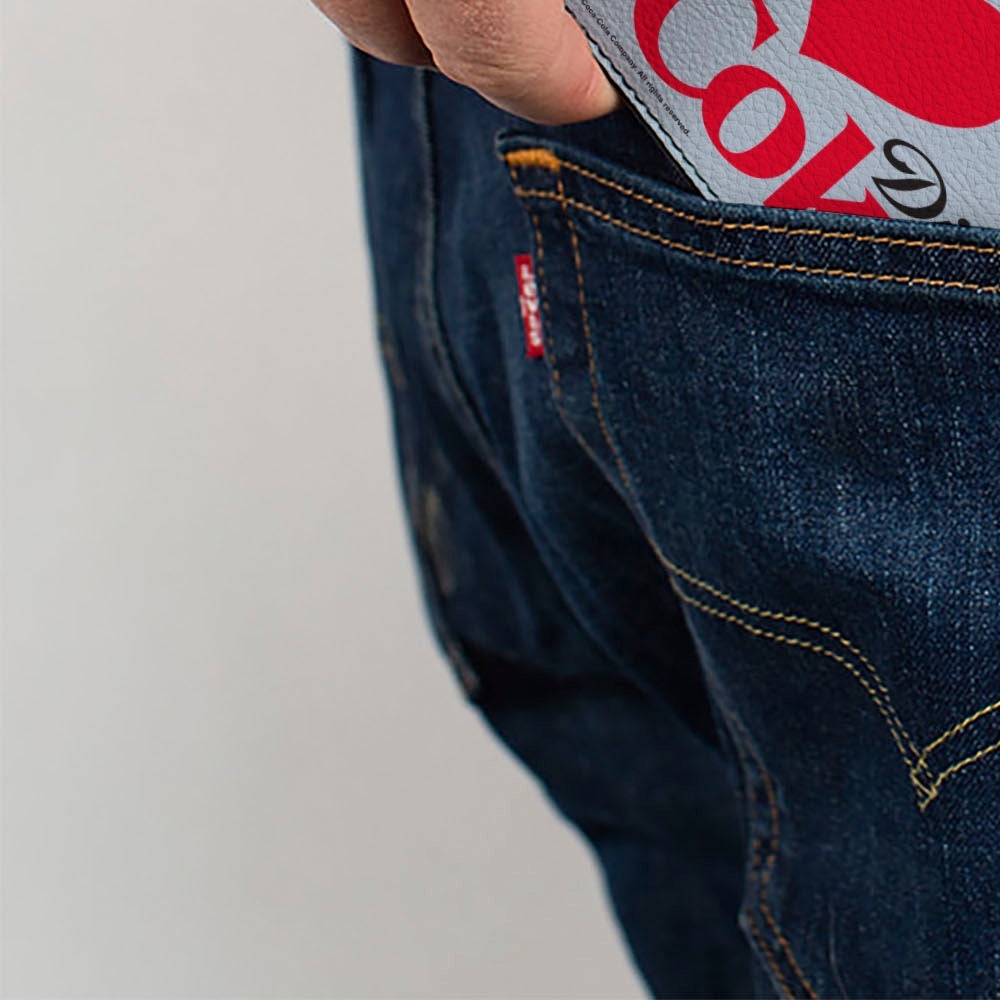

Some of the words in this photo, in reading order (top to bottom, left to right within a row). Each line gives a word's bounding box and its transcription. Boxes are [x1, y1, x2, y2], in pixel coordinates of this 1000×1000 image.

[637, 70, 648, 82] All
[646, 81, 664, 104] rights
[662, 103, 691, 137] reserved.
[871, 138, 971, 227] D
